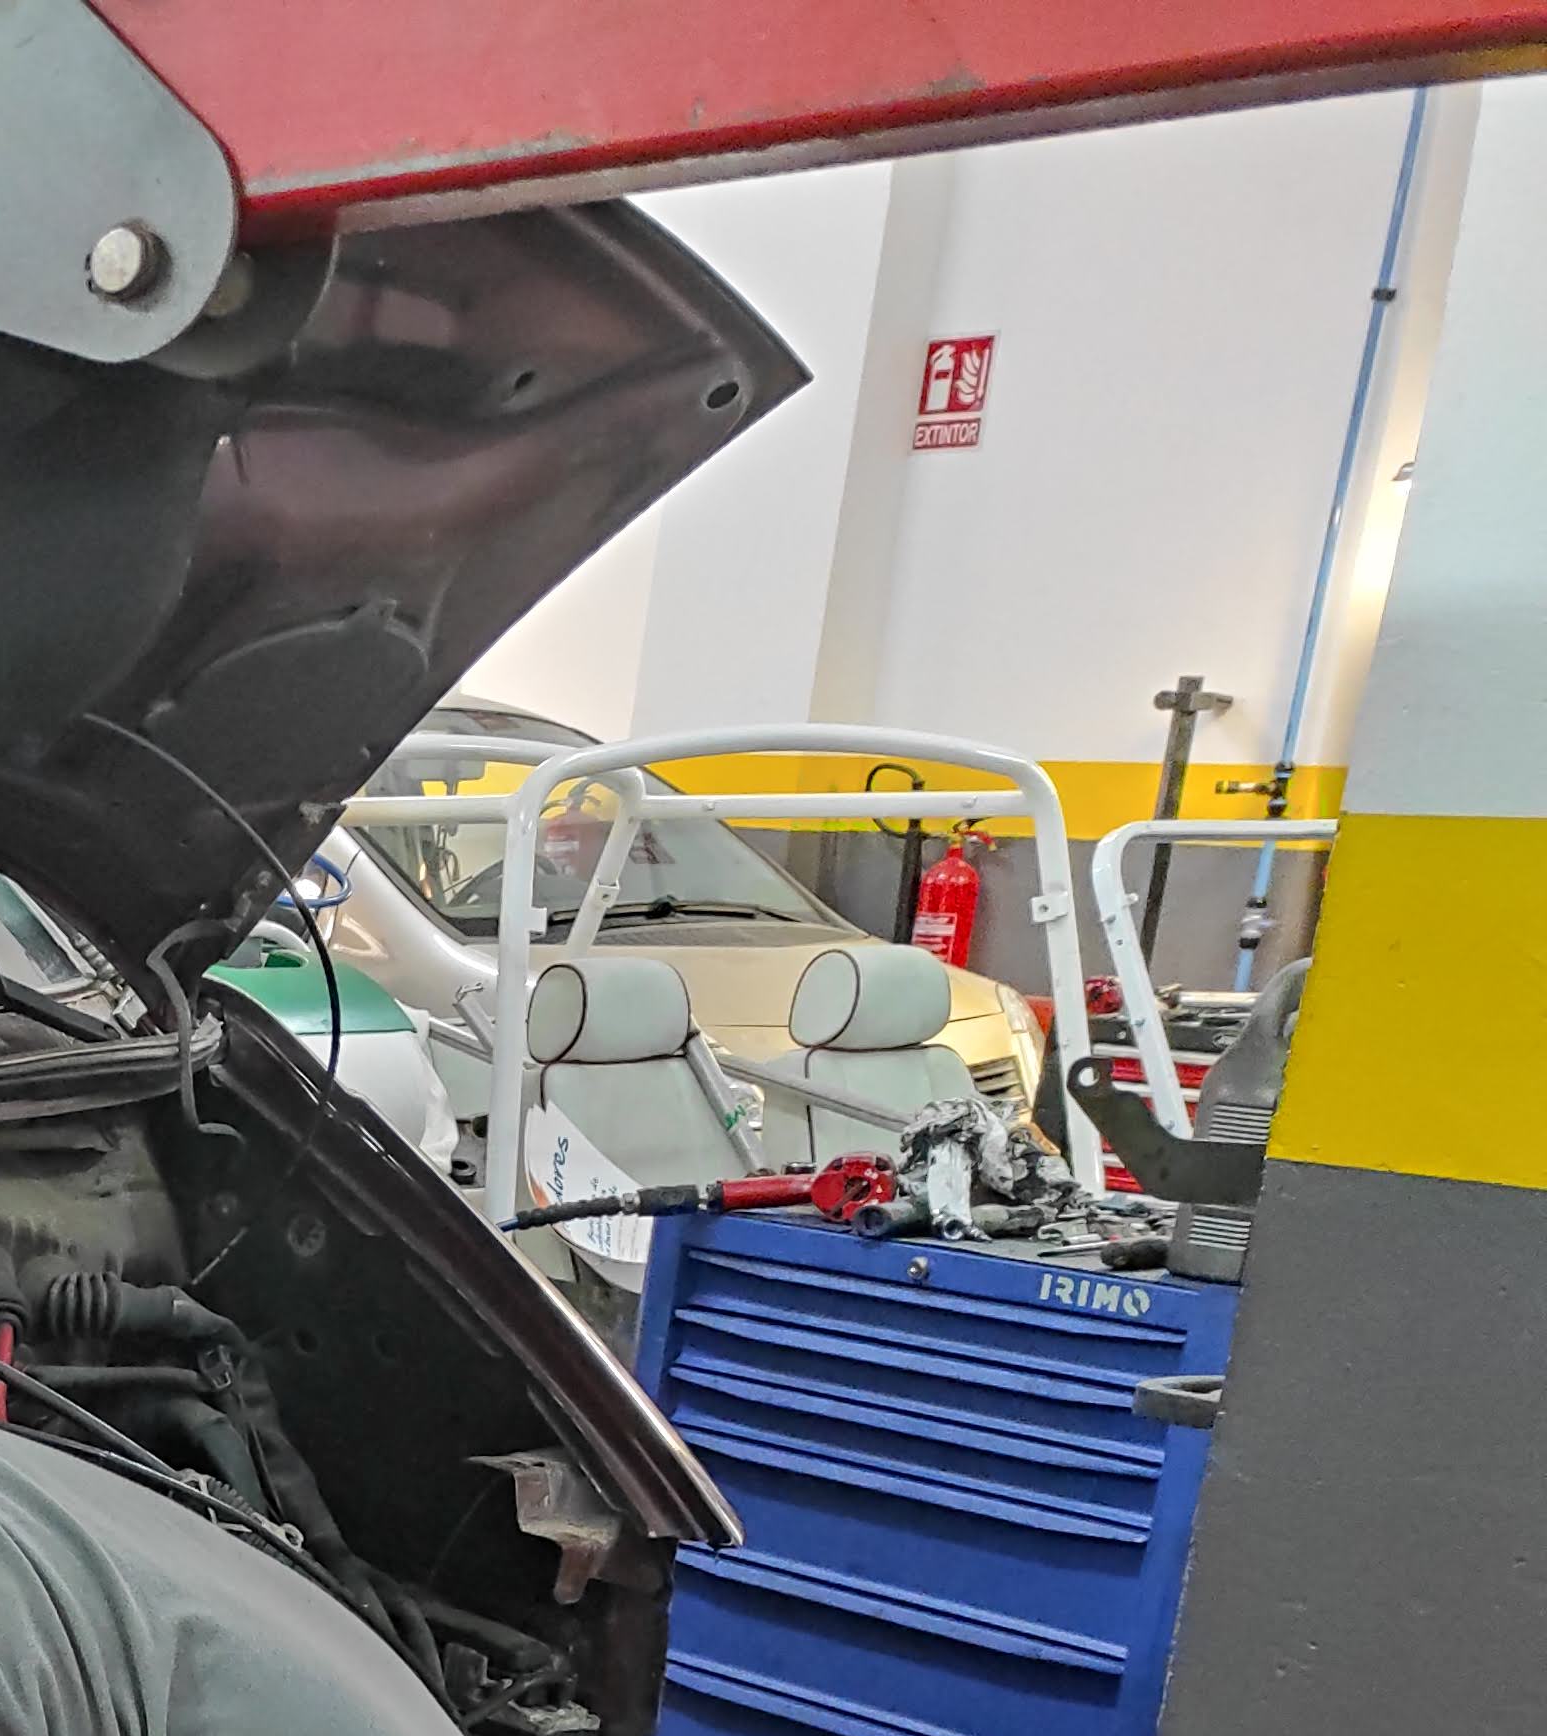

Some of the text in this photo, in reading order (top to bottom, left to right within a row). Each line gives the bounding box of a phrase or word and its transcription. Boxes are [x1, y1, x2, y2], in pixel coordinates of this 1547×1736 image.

[915, 422, 979, 446] EXTINTOR
[546, 1136, 569, 1206] dores
[1039, 1273, 1151, 1317] IRIMO
